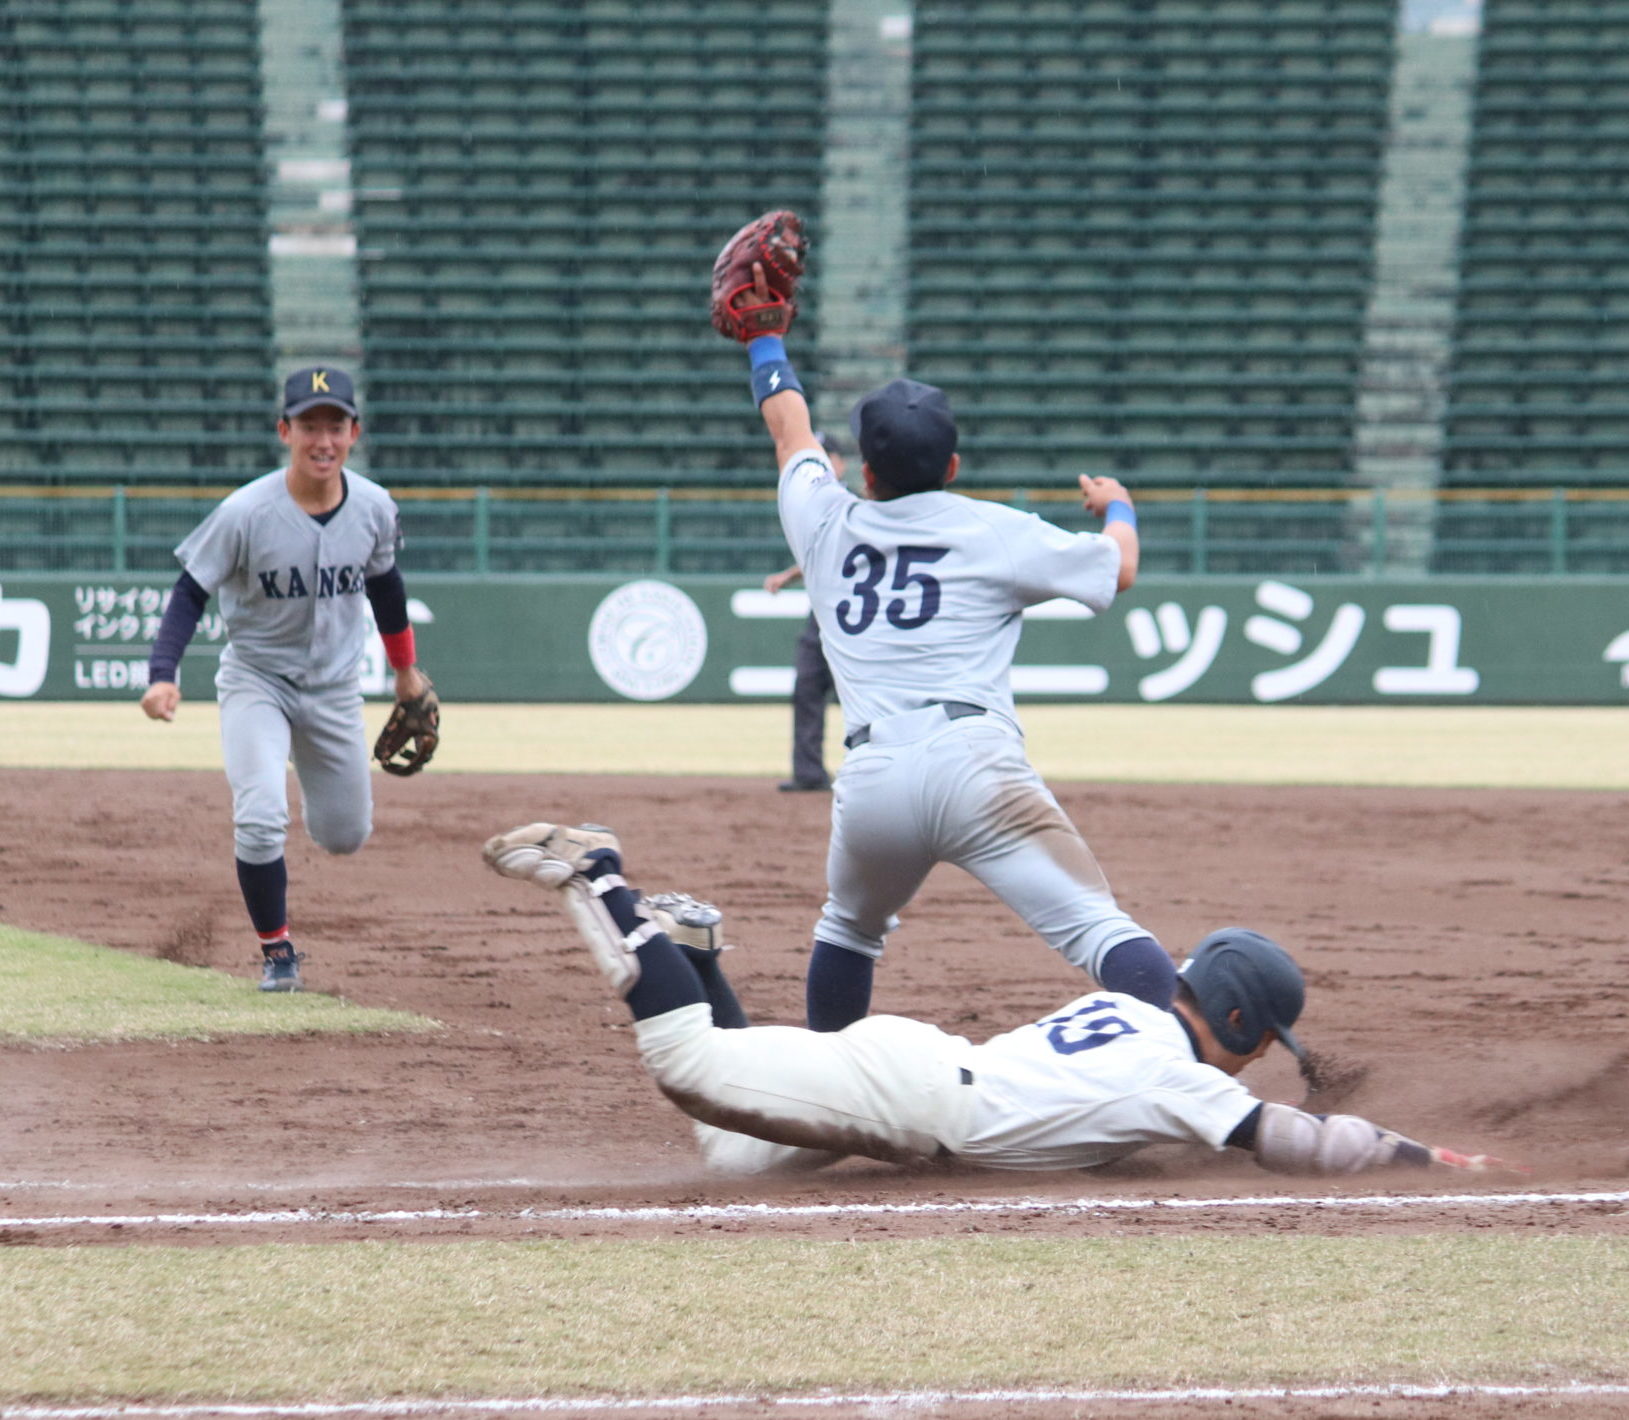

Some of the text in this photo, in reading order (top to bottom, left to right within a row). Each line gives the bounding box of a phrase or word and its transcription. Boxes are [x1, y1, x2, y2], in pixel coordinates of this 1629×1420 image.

[312, 371, 331, 393] K
[836, 543, 951, 636] 35
[1036, 1000, 1140, 1056] 19
